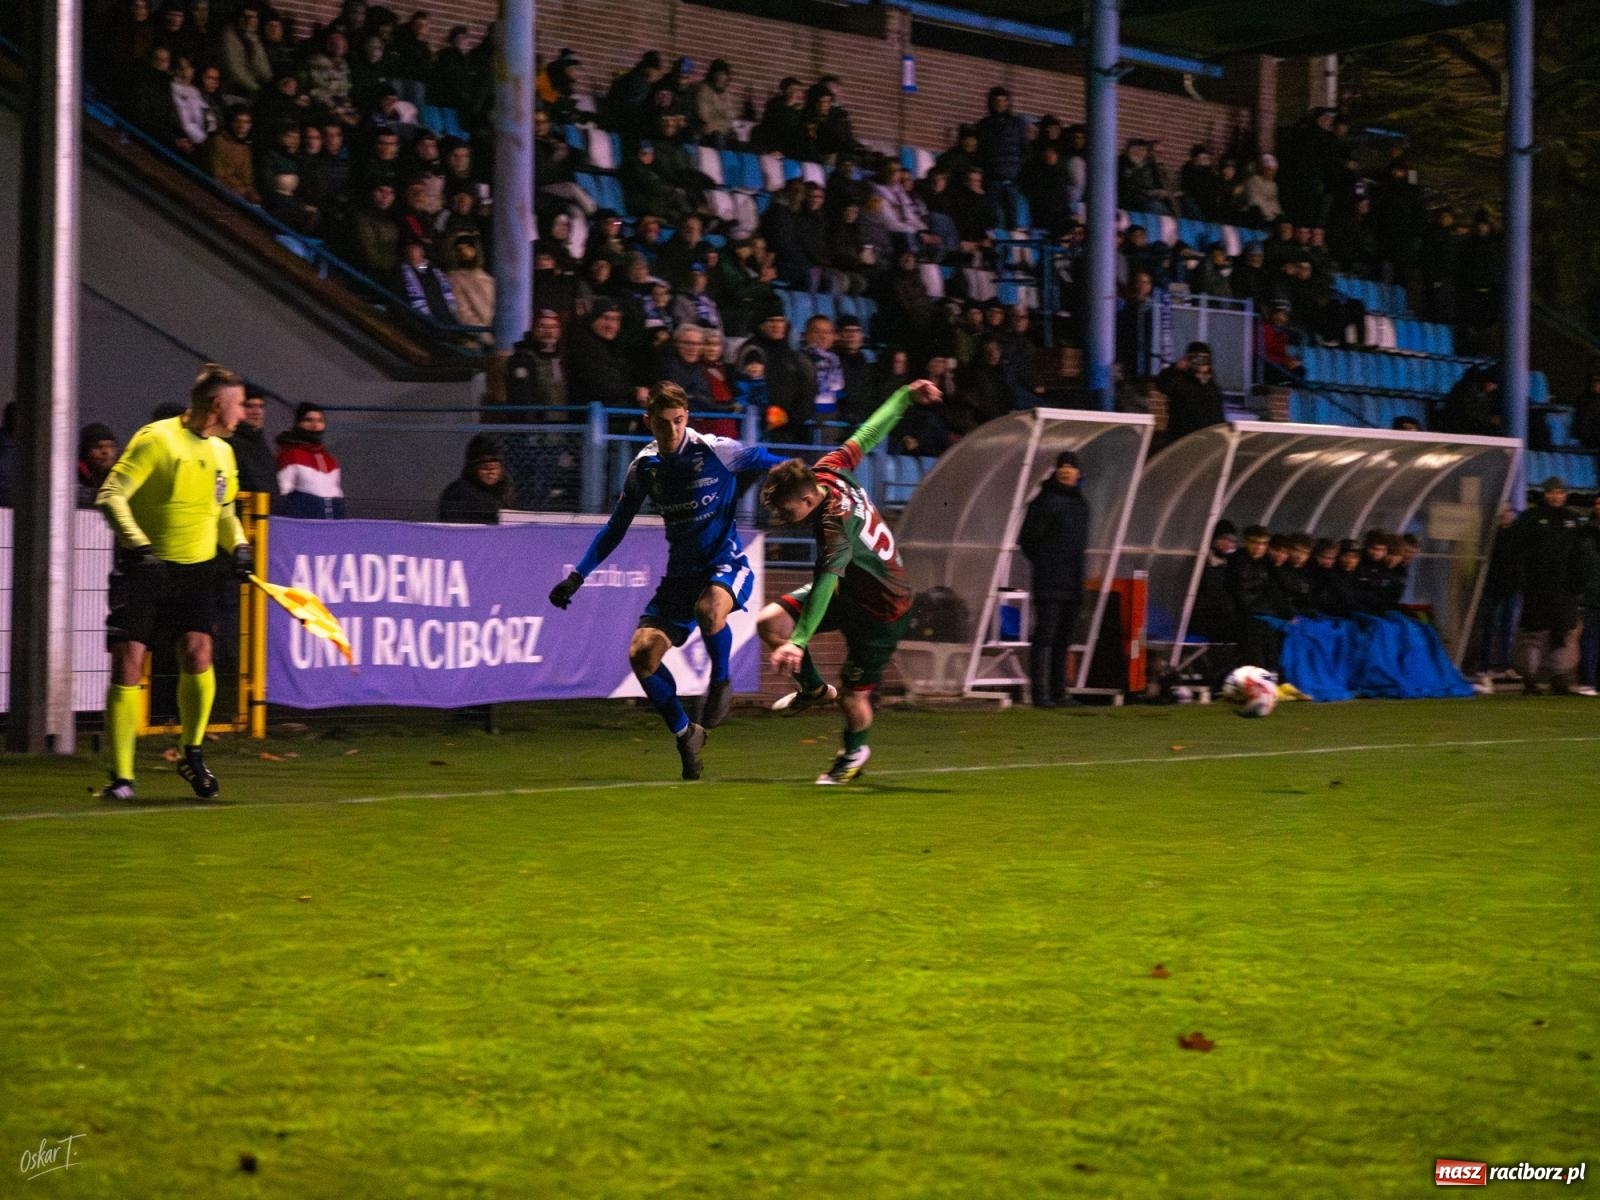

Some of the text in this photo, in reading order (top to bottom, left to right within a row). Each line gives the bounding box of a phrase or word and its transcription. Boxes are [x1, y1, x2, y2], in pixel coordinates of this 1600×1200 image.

[858, 488, 895, 561] 5
[290, 554, 470, 608] AKADEMIA
[372, 604, 544, 670] RACIBÓRZ
